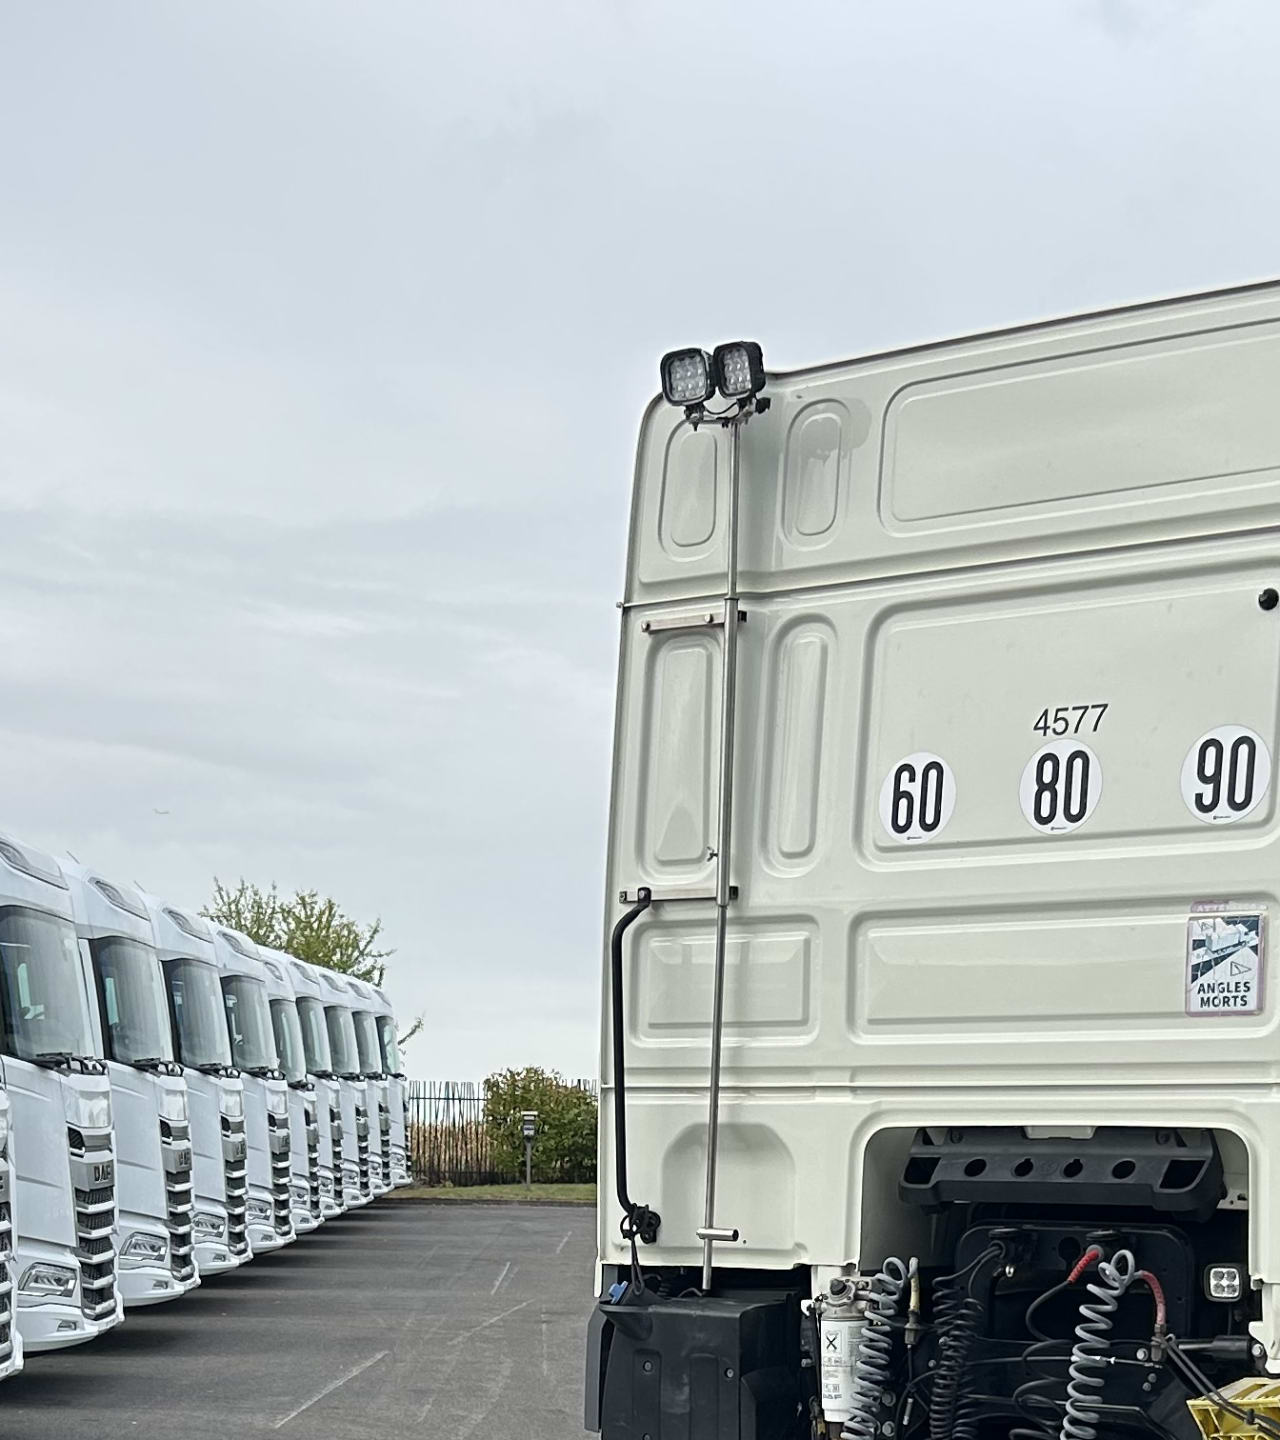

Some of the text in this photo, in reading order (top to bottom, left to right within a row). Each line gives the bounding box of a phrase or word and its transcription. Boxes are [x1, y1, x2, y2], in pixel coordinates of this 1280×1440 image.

[1033, 703, 1109, 737] 4577
[891, 760, 944, 834] 60
[1033, 749, 1090, 826] 80
[1194, 735, 1257, 814] 90
[1197, 981, 1252, 995] ANGLES
[1200, 995, 1248, 1008] MORTS
